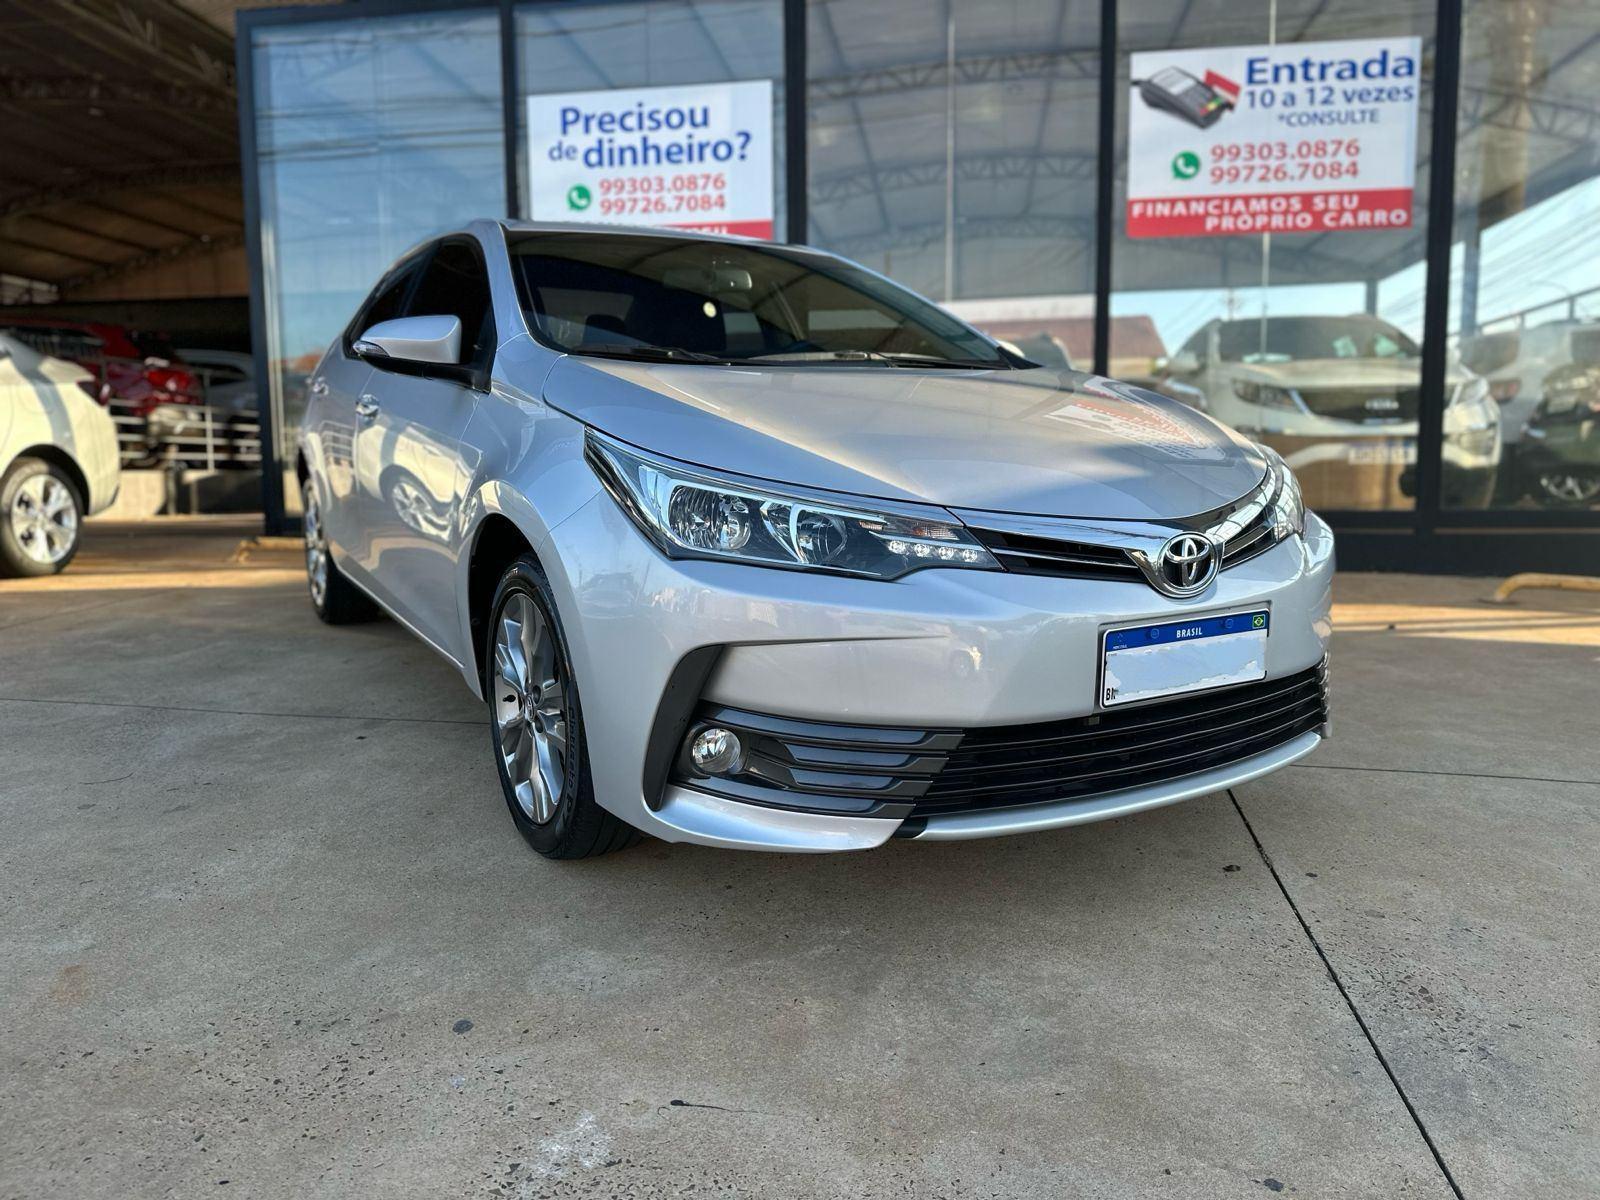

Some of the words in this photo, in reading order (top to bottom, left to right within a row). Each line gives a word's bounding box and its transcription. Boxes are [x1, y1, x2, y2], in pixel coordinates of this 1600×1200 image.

[1246, 50, 1414, 85] Entrada
[1247, 90, 1275, 108] 10
[1282, 92, 1296, 107] a
[1306, 87, 1334, 106] 12
[1343, 84, 1414, 104] vezes
[560, 103, 709, 135] Precisou
[548, 140, 578, 161] de
[583, 131, 753, 169] dinheiro?
[1211, 139, 1360, 162] 99303.0876
[599, 174, 726, 194] 99303.0876
[1210, 161, 1359, 184] 99726.7084
[600, 195, 725, 213] 99726.7084
[1131, 195, 1303, 219] FINANCIAMOS
[1312, 194, 1359, 210] SEU
[1323, 208, 1408, 227] CARRO
[1176, 627, 1203, 638] BRASIL
